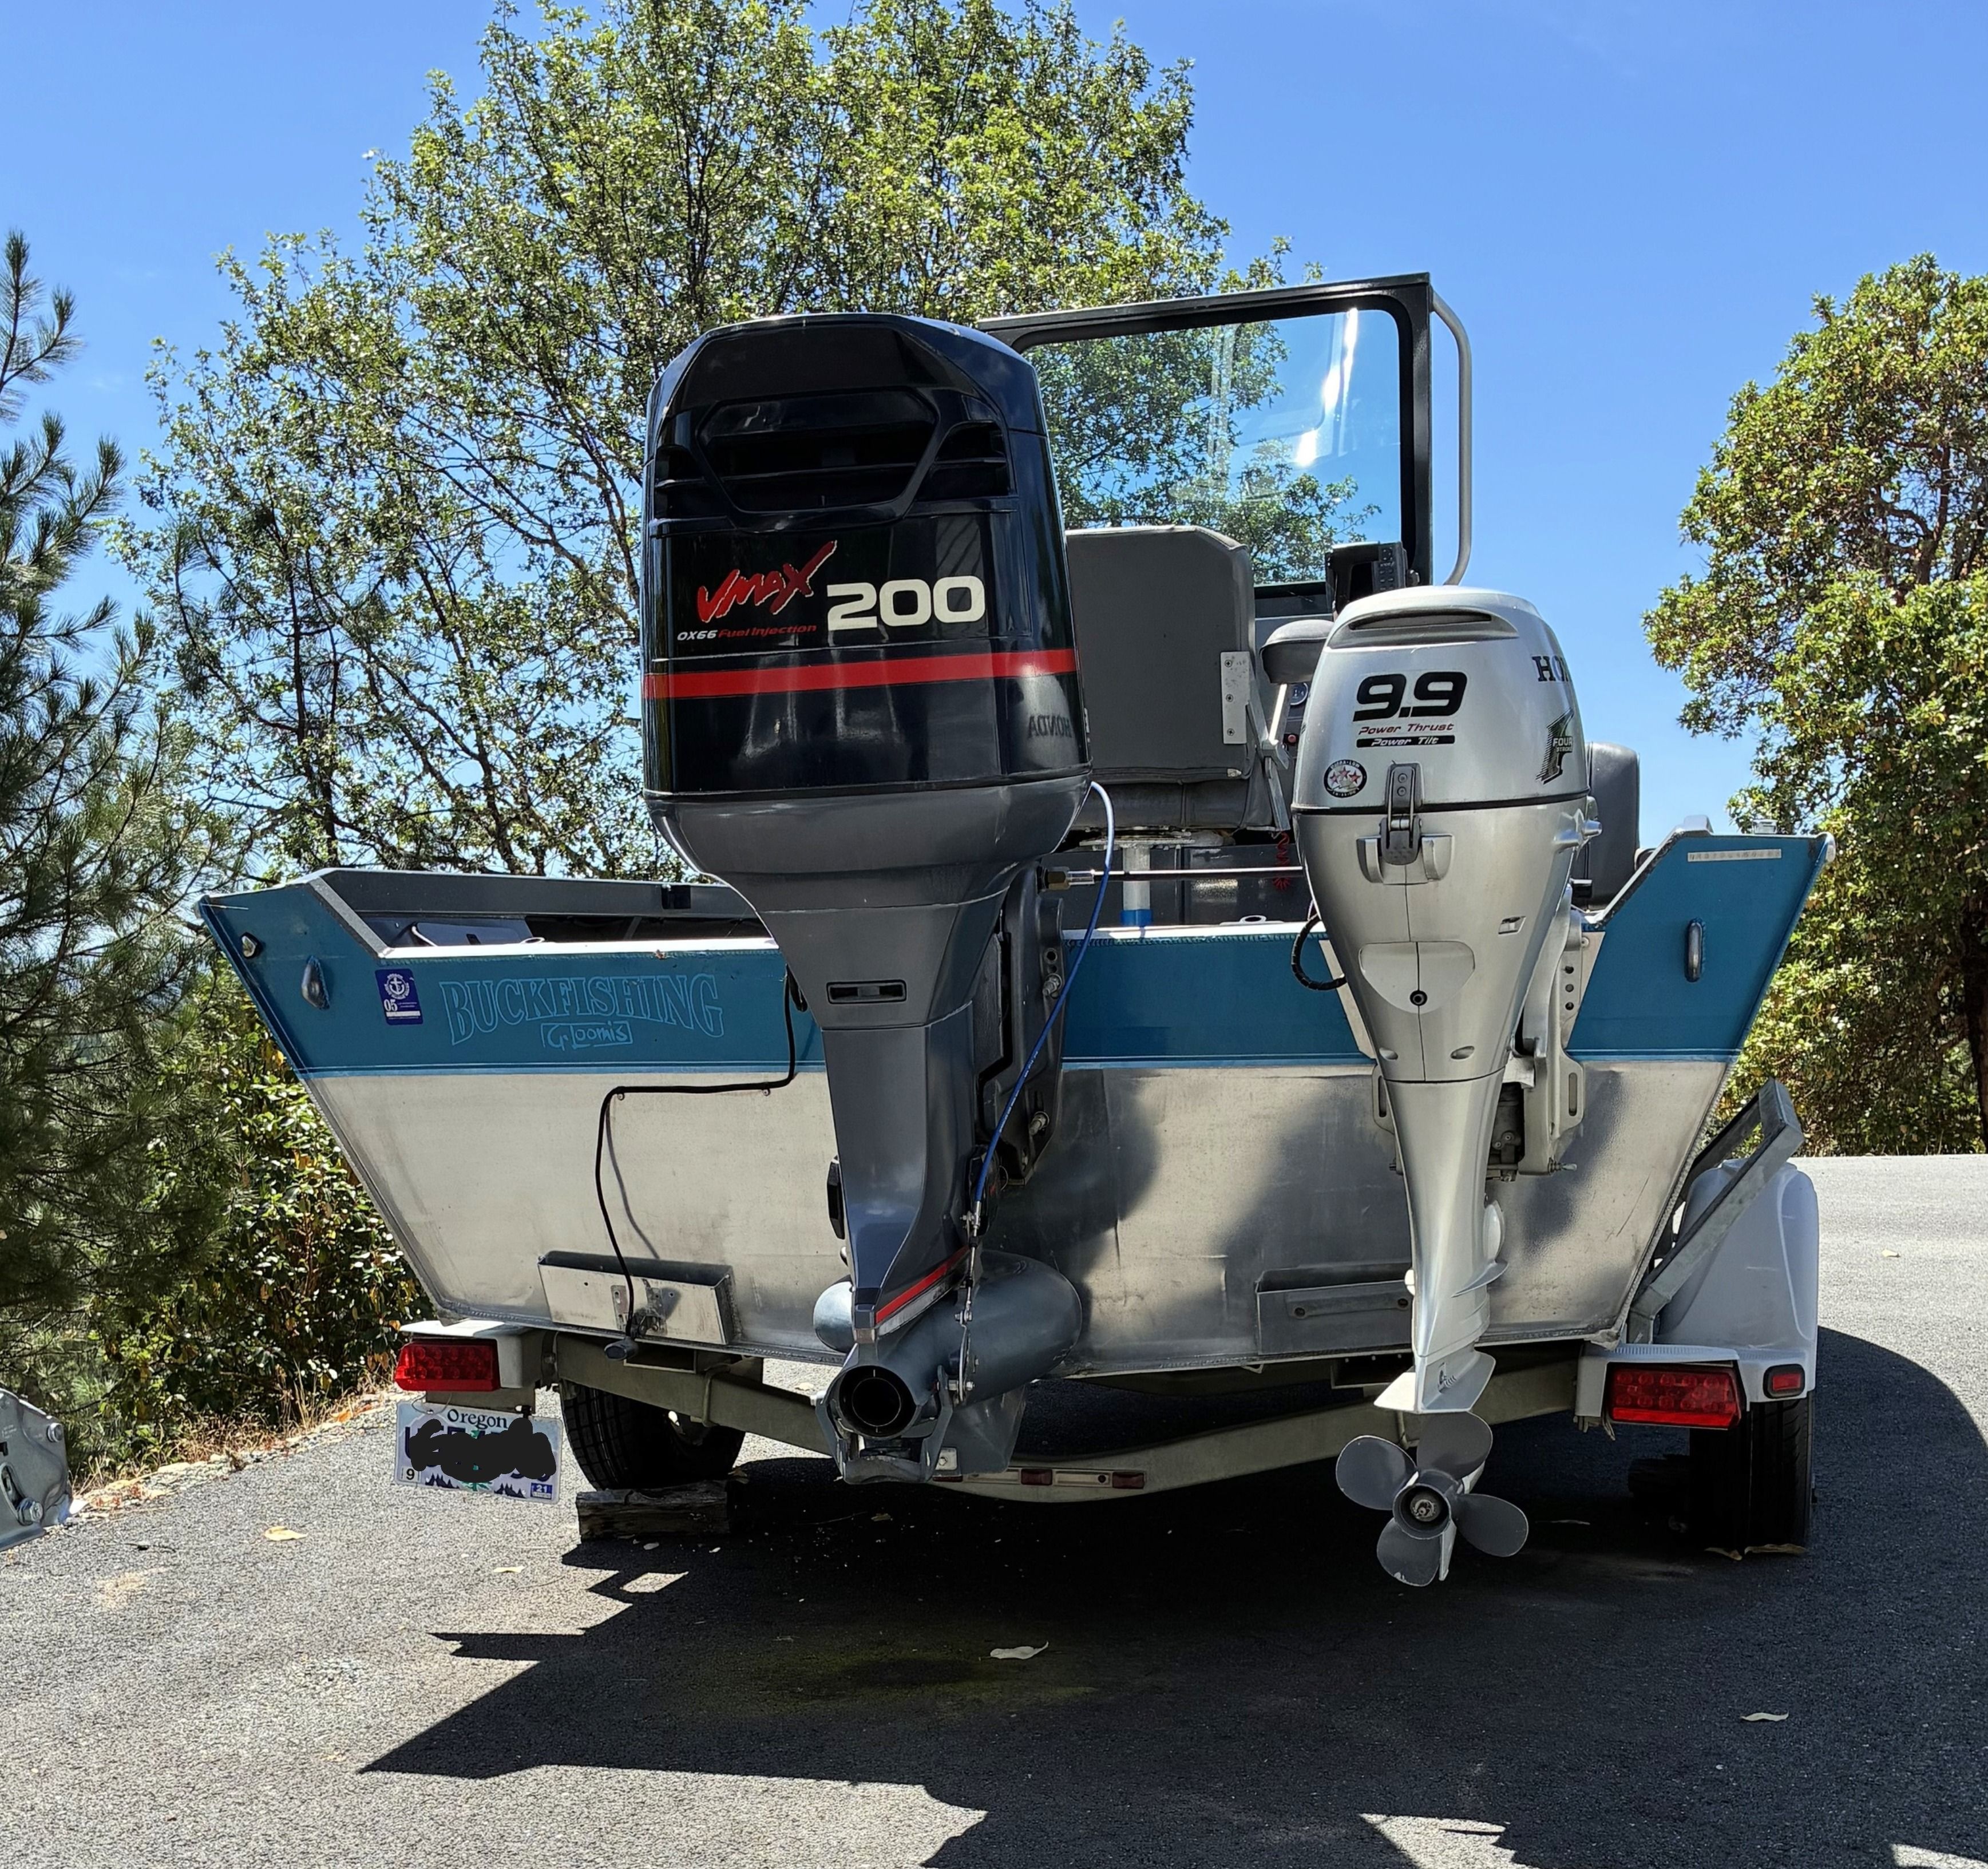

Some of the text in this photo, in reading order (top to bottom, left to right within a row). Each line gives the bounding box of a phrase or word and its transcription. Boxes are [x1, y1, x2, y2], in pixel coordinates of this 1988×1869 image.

[827, 576, 985, 631] 200
[677, 624, 817, 641] OX66 Fuel Injection
[1353, 672, 1467, 722] 9.9
[1359, 723, 1455, 735] Power Thrust
[1371, 736, 1439, 746] Power Tilt
[1553, 737, 1573, 747] FOUR
[384, 999, 398, 1012] 05
[439, 973, 724, 1046] BUCKFISHING
[447, 1408, 508, 1429] Oregon
[406, 1468, 415, 1480] 9
[536, 1484, 548, 1493] 21
